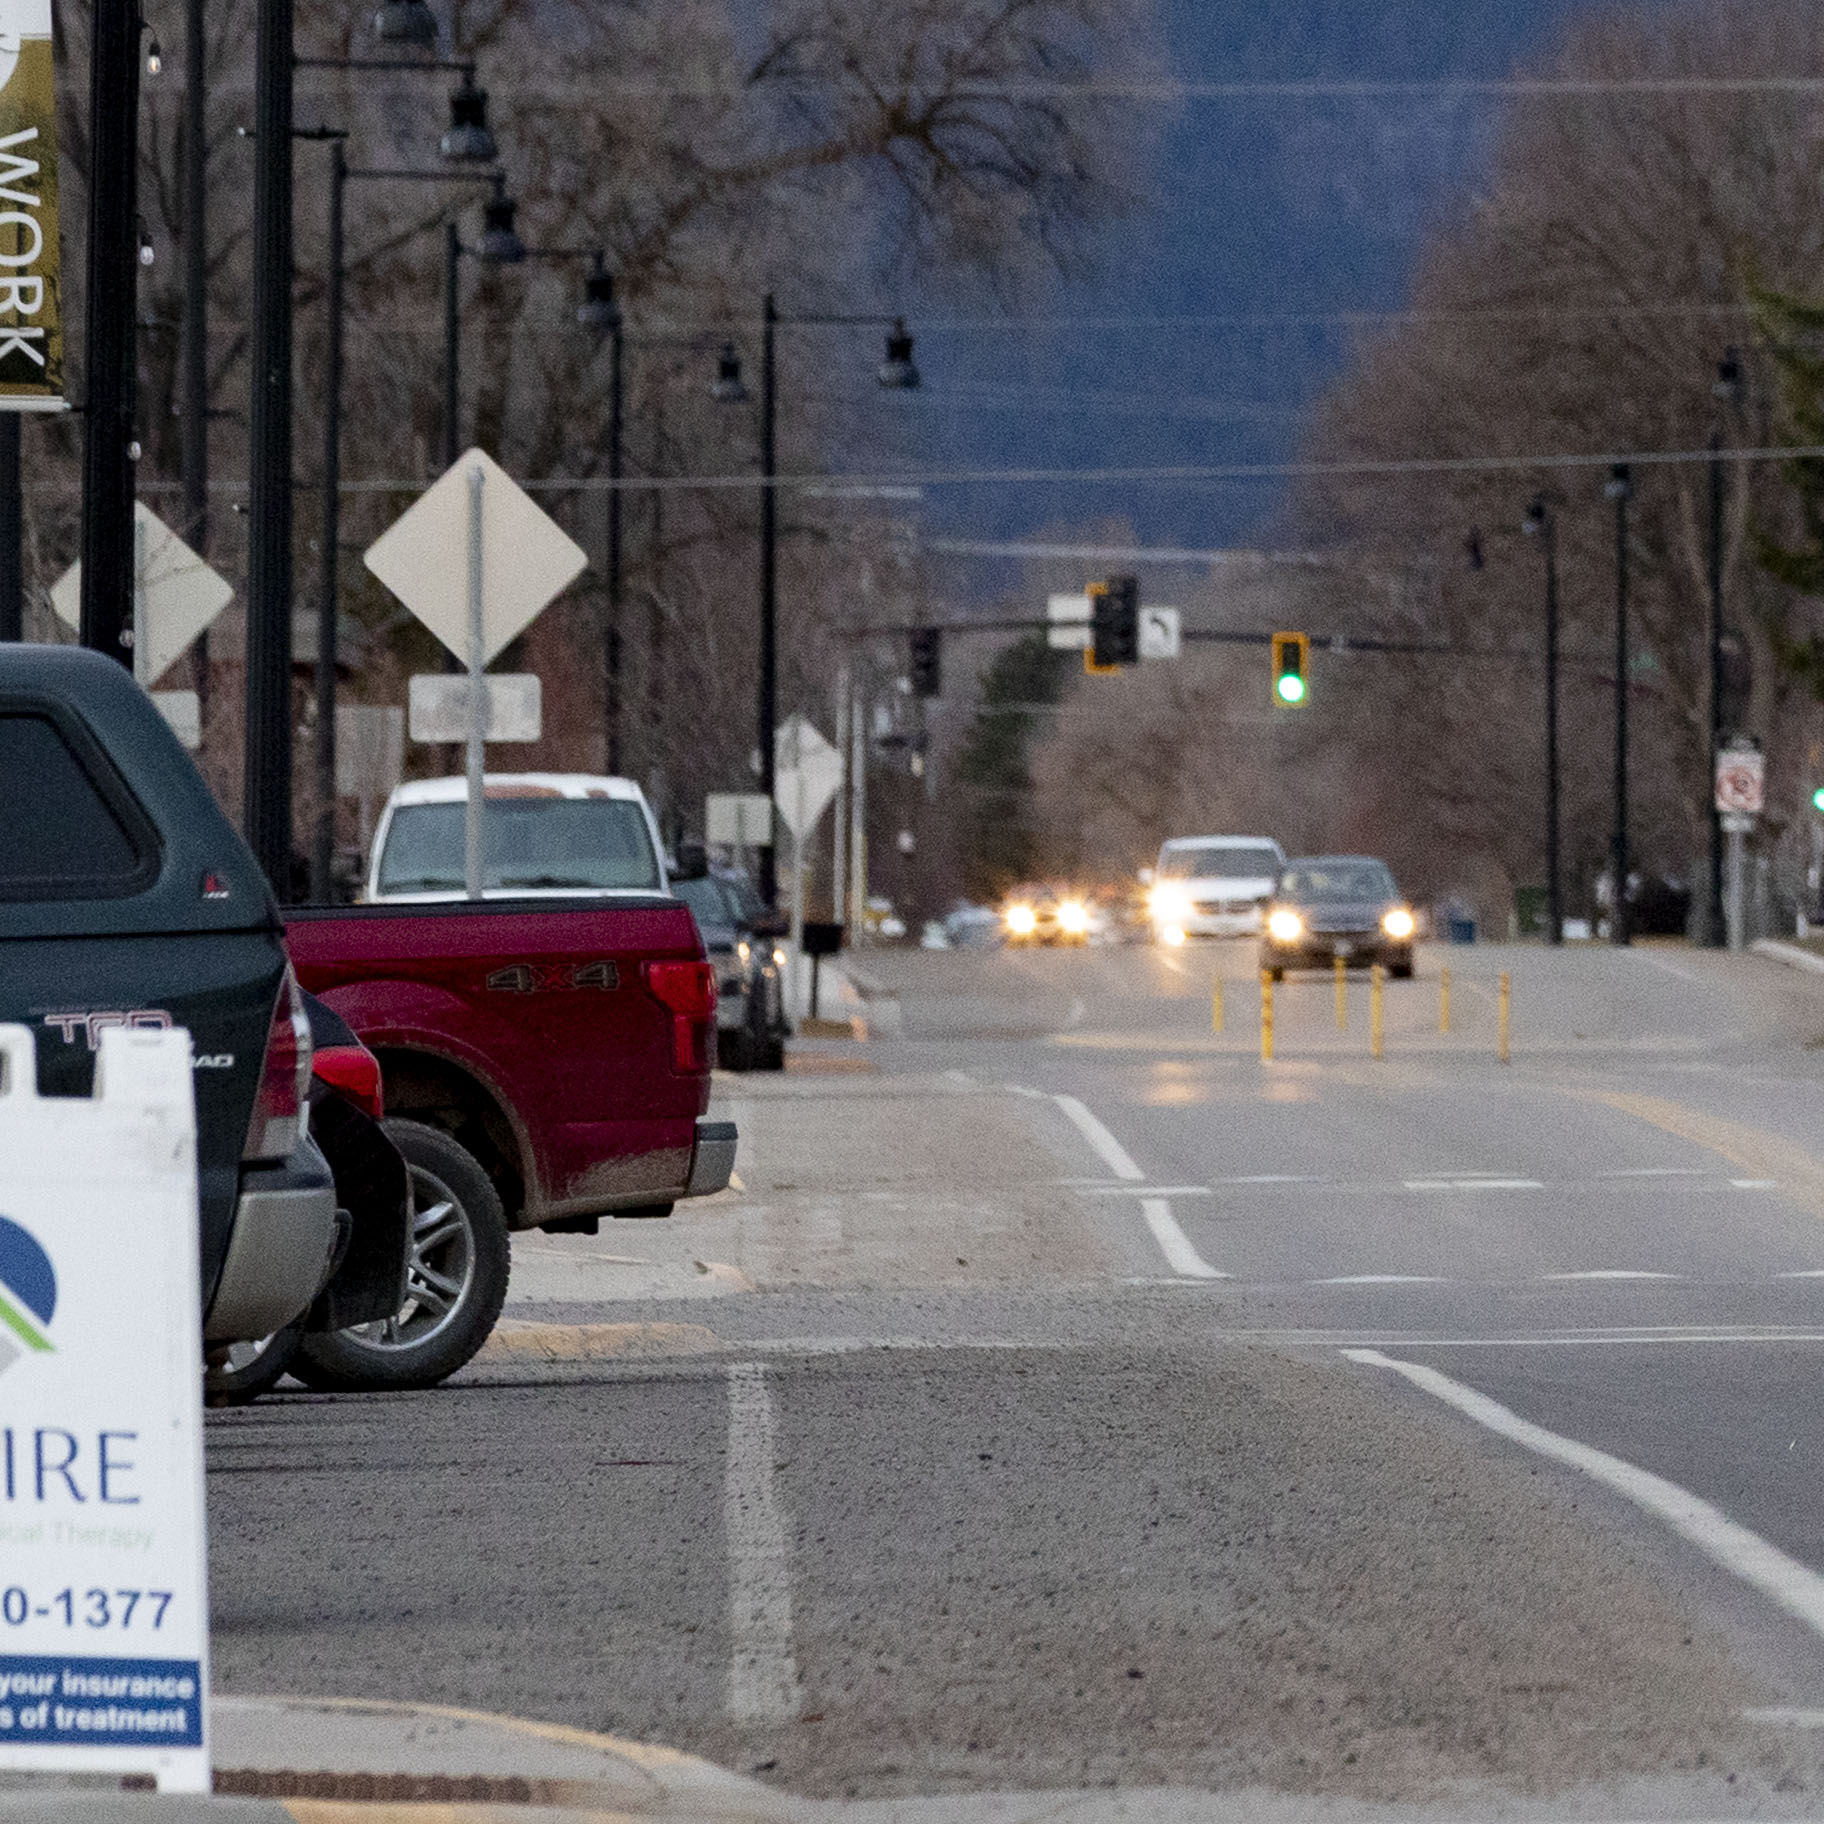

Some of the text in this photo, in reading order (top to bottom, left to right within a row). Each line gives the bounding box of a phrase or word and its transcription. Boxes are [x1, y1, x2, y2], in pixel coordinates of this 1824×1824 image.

[0, 126, 45, 368] WORK
[5, 1428, 141, 1506] IRE
[2, 1587, 173, 1629] 0-1377
[62, 1669, 195, 1700] insurance
[19, 1701, 50, 1729] of
[54, 1704, 188, 1733] treatment
